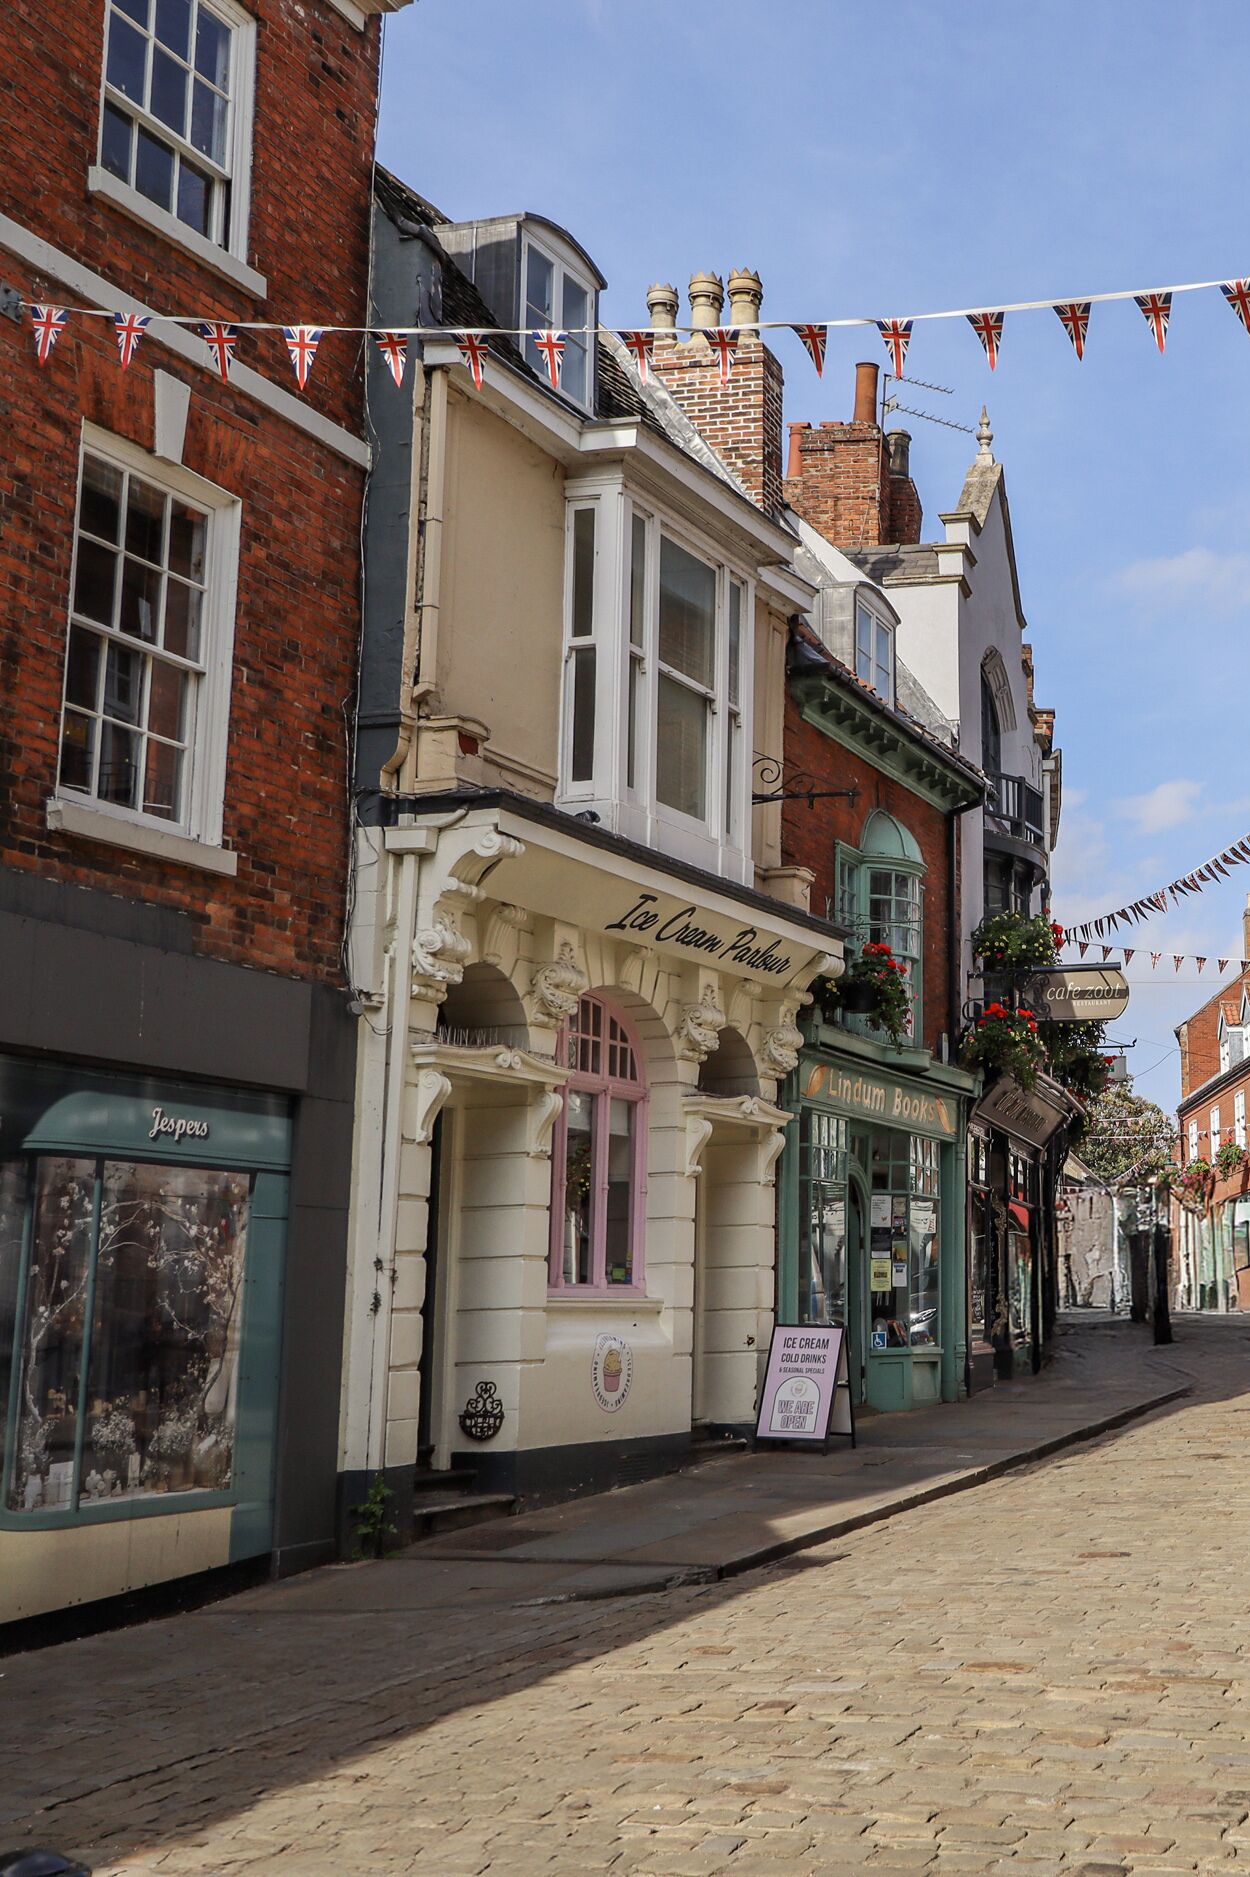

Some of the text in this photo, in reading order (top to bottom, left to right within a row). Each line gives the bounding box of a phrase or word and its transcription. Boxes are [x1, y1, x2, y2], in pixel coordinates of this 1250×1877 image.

[604, 893, 791, 975] Ice Cream Parlour
[1046, 982, 1121, 1001] cafe zoot
[828, 1068, 935, 1124] Lindum Books
[148, 1107, 208, 1141] Jespers
[783, 1337, 829, 1350] ICE CREAM
[781, 1353, 827, 1365] COLD DRINKS
[805, 1367, 825, 1375] SPECIALS
[778, 1400, 815, 1415] WE ARE
[780, 1415, 807, 1430] OPEN
